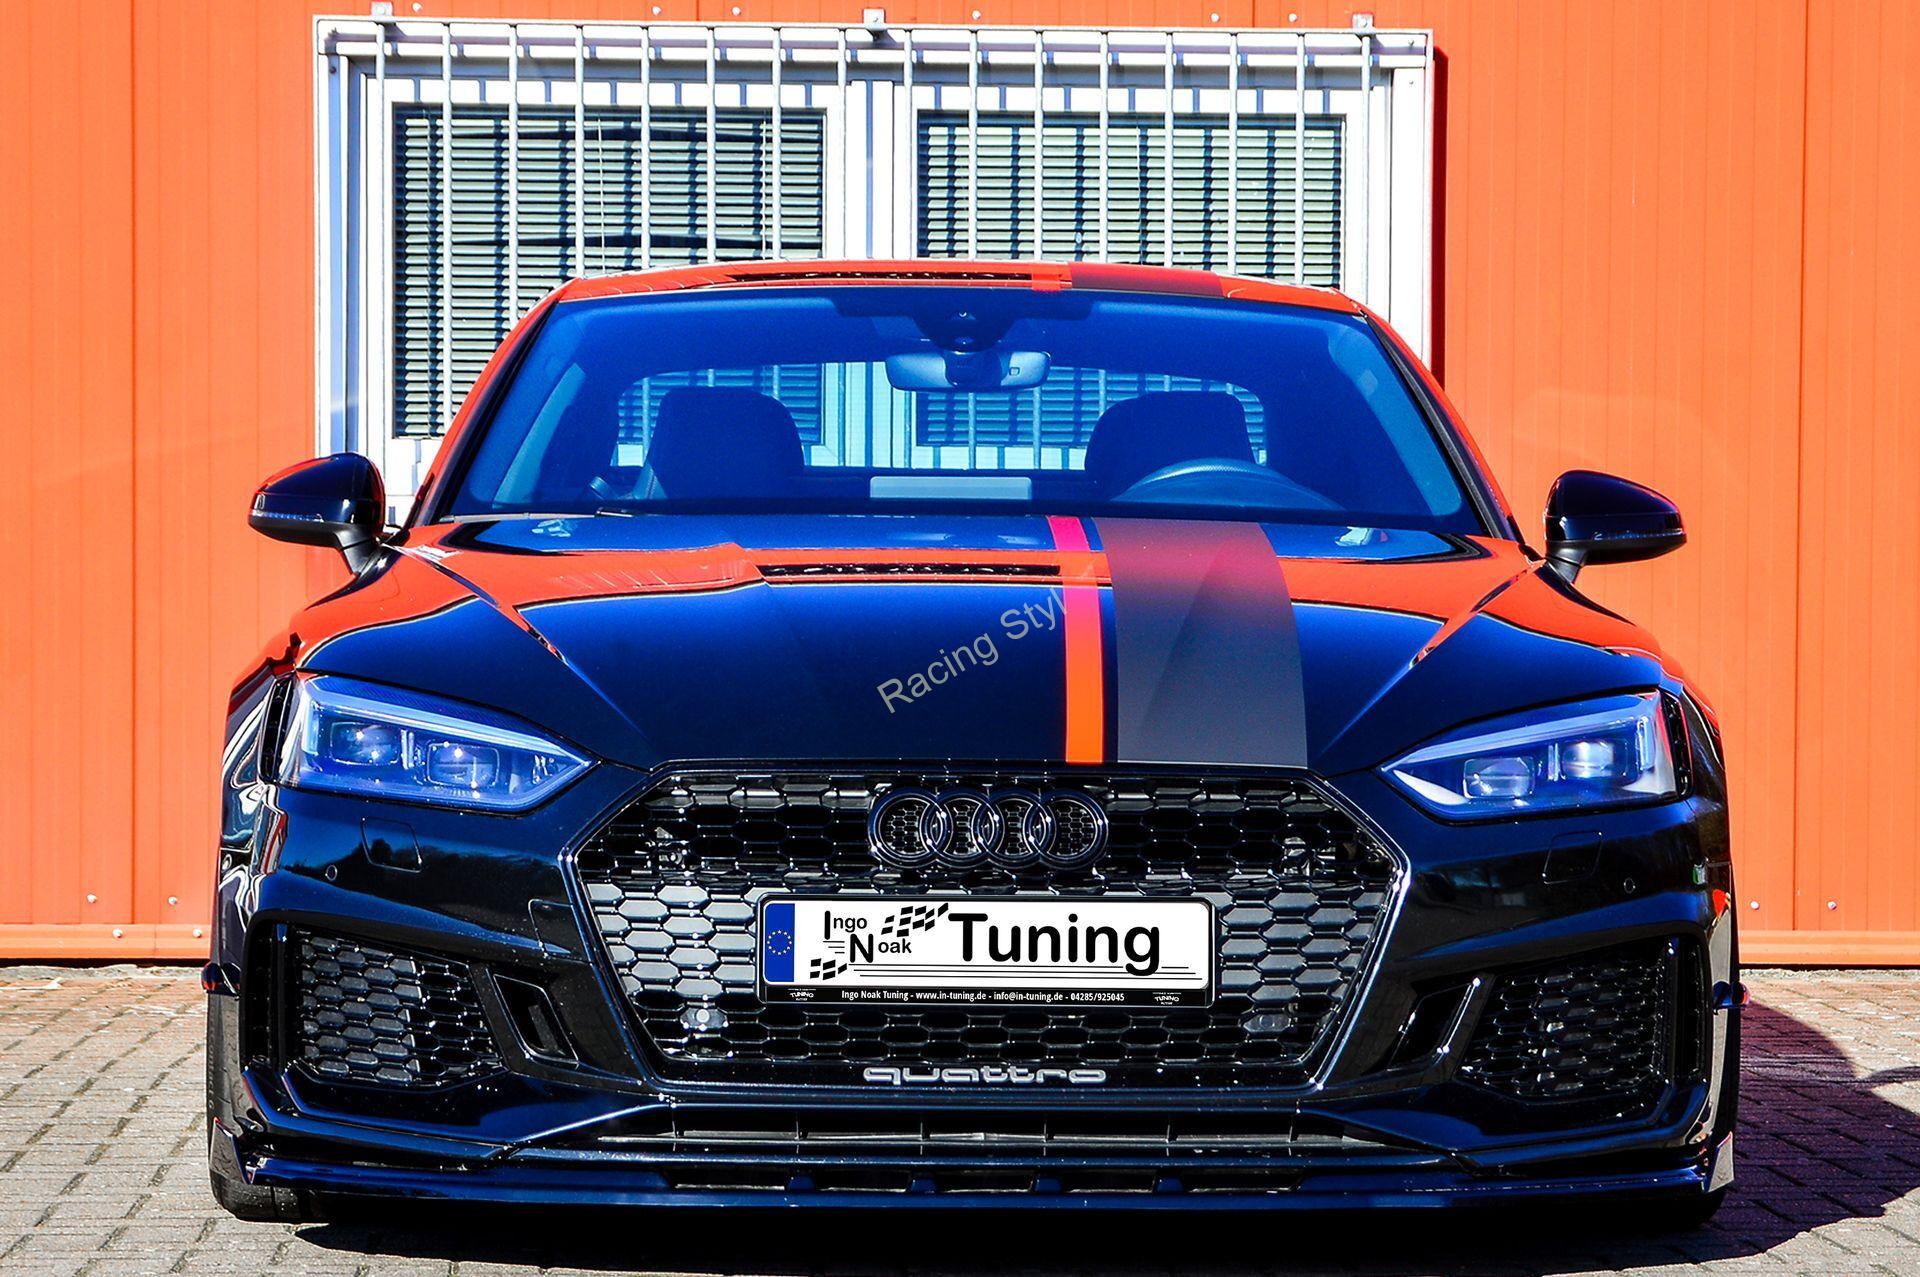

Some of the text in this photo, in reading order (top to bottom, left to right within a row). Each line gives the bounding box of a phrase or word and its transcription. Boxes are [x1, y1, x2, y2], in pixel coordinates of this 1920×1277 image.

[824, 910, 868, 941] Ingo
[849, 933, 912, 964] Noak
[947, 912, 1160, 977] Tuning
[841, 990, 859, 1001] Ingo
[861, 990, 881, 999] Noak
[883, 990, 909, 1001] Tuning
[916, 991, 986, 1003] www.in-tuning.de
[993, 991, 1063, 1003] info@in-tuning.de
[1070, 992, 1125, 1002] 04285/925045
[862, 1065, 1107, 1086] quattro
